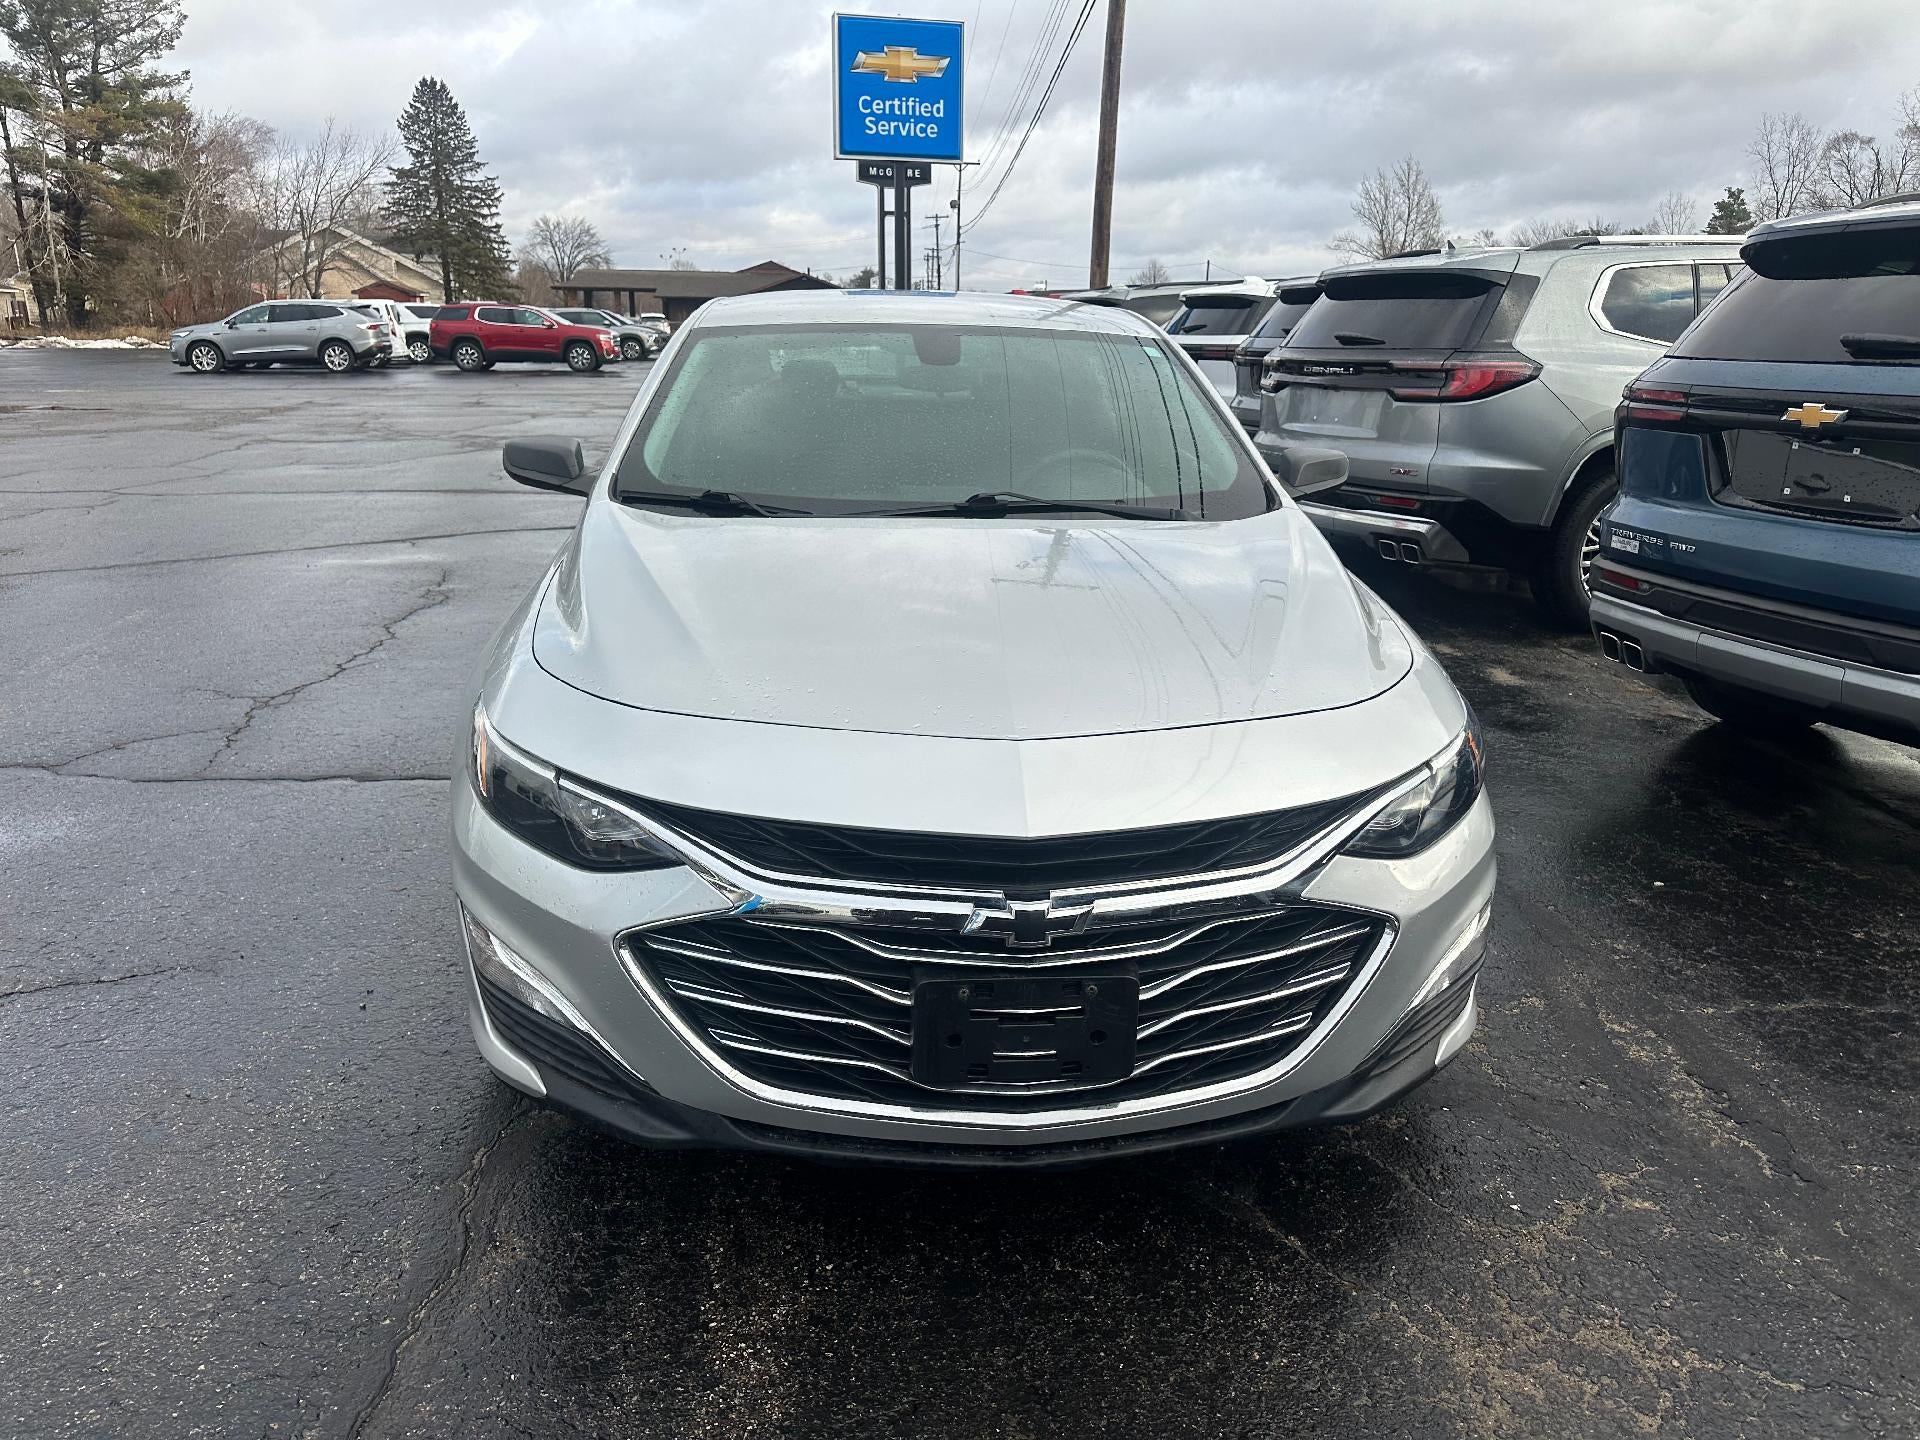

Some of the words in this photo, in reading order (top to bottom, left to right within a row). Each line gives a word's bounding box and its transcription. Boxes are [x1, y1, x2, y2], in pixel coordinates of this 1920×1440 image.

[858, 95, 944, 118] Certified
[865, 116, 938, 138] Service
[869, 166, 921, 178] McGRE
[1304, 367, 1353, 376] DENALI
[1610, 527, 1665, 546] TRAVERSE
[1669, 541, 1696, 553] AWD
